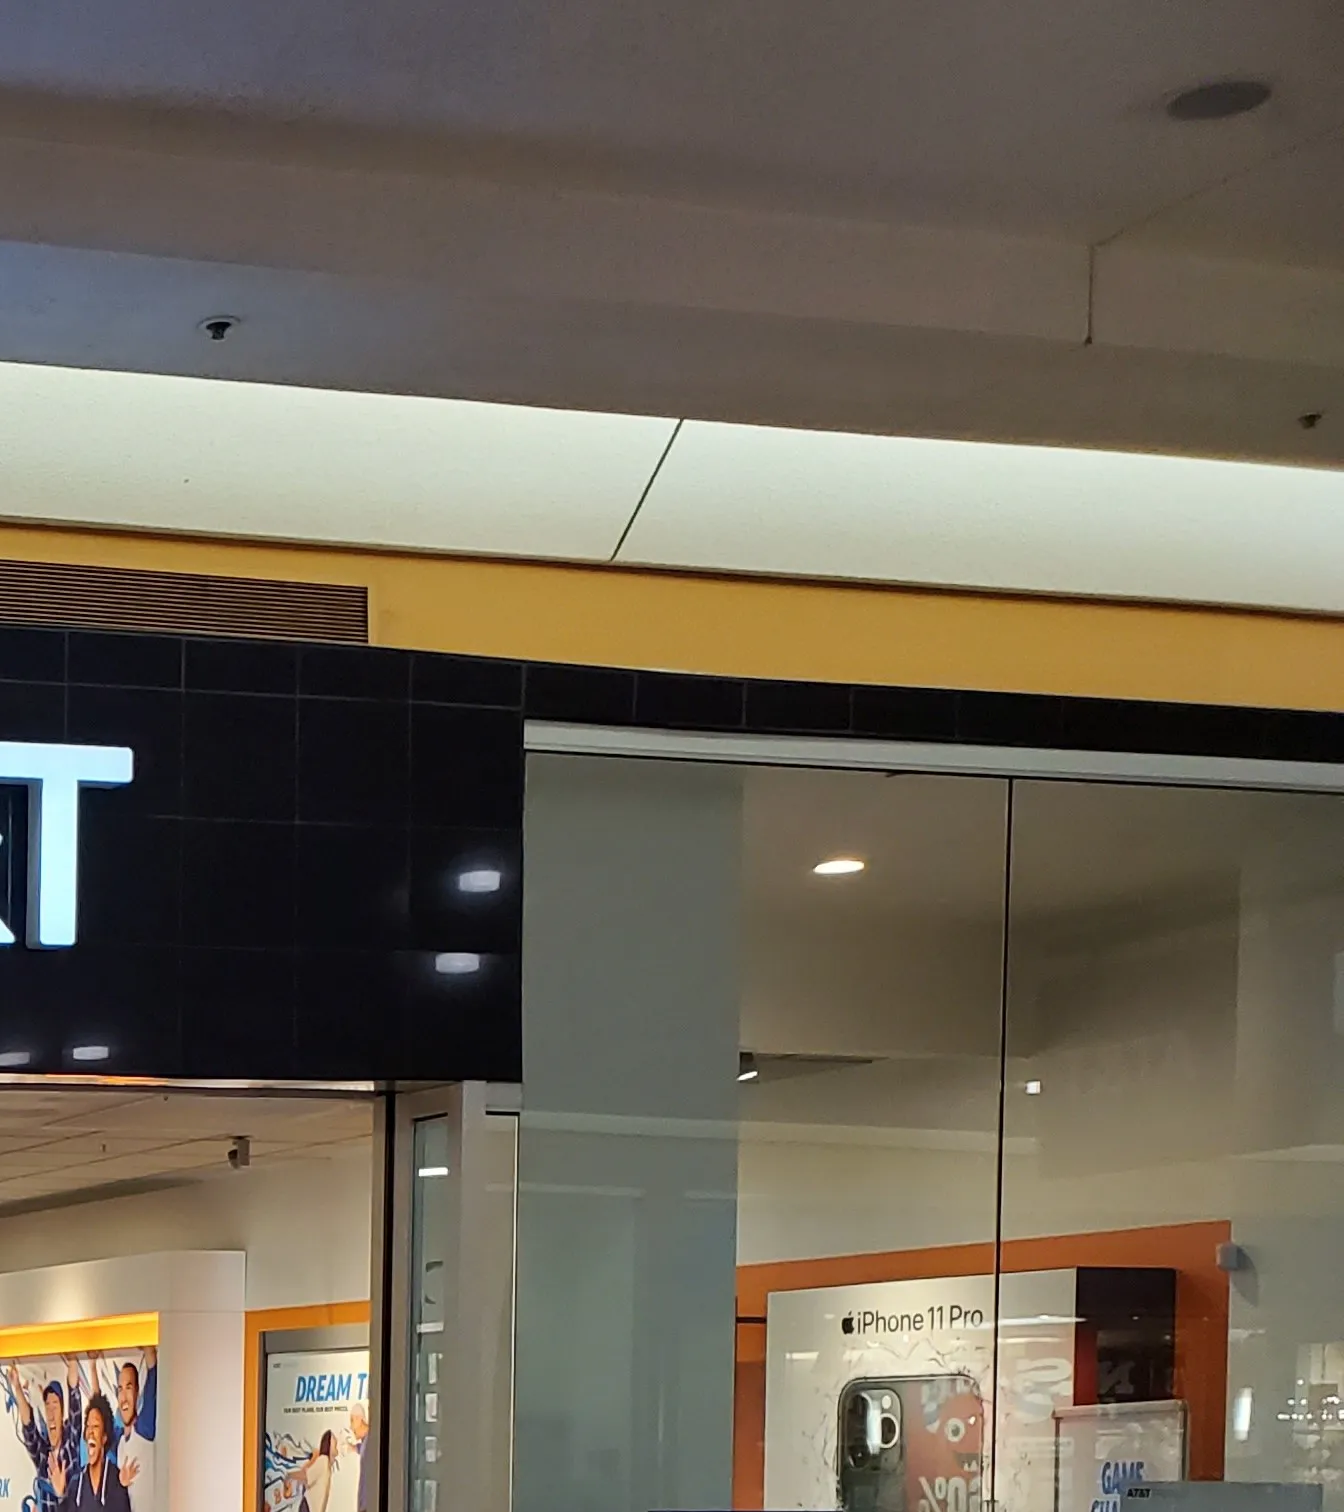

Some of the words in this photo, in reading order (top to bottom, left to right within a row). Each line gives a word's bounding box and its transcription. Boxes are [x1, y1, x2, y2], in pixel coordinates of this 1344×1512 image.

[857, 1310, 924, 1335] iPhone
[928, 1306, 944, 1331] 11
[950, 1304, 984, 1328] Pro
[295, 1373, 352, 1403] DREAM
[1127, 1488, 1151, 1499] AT&T
